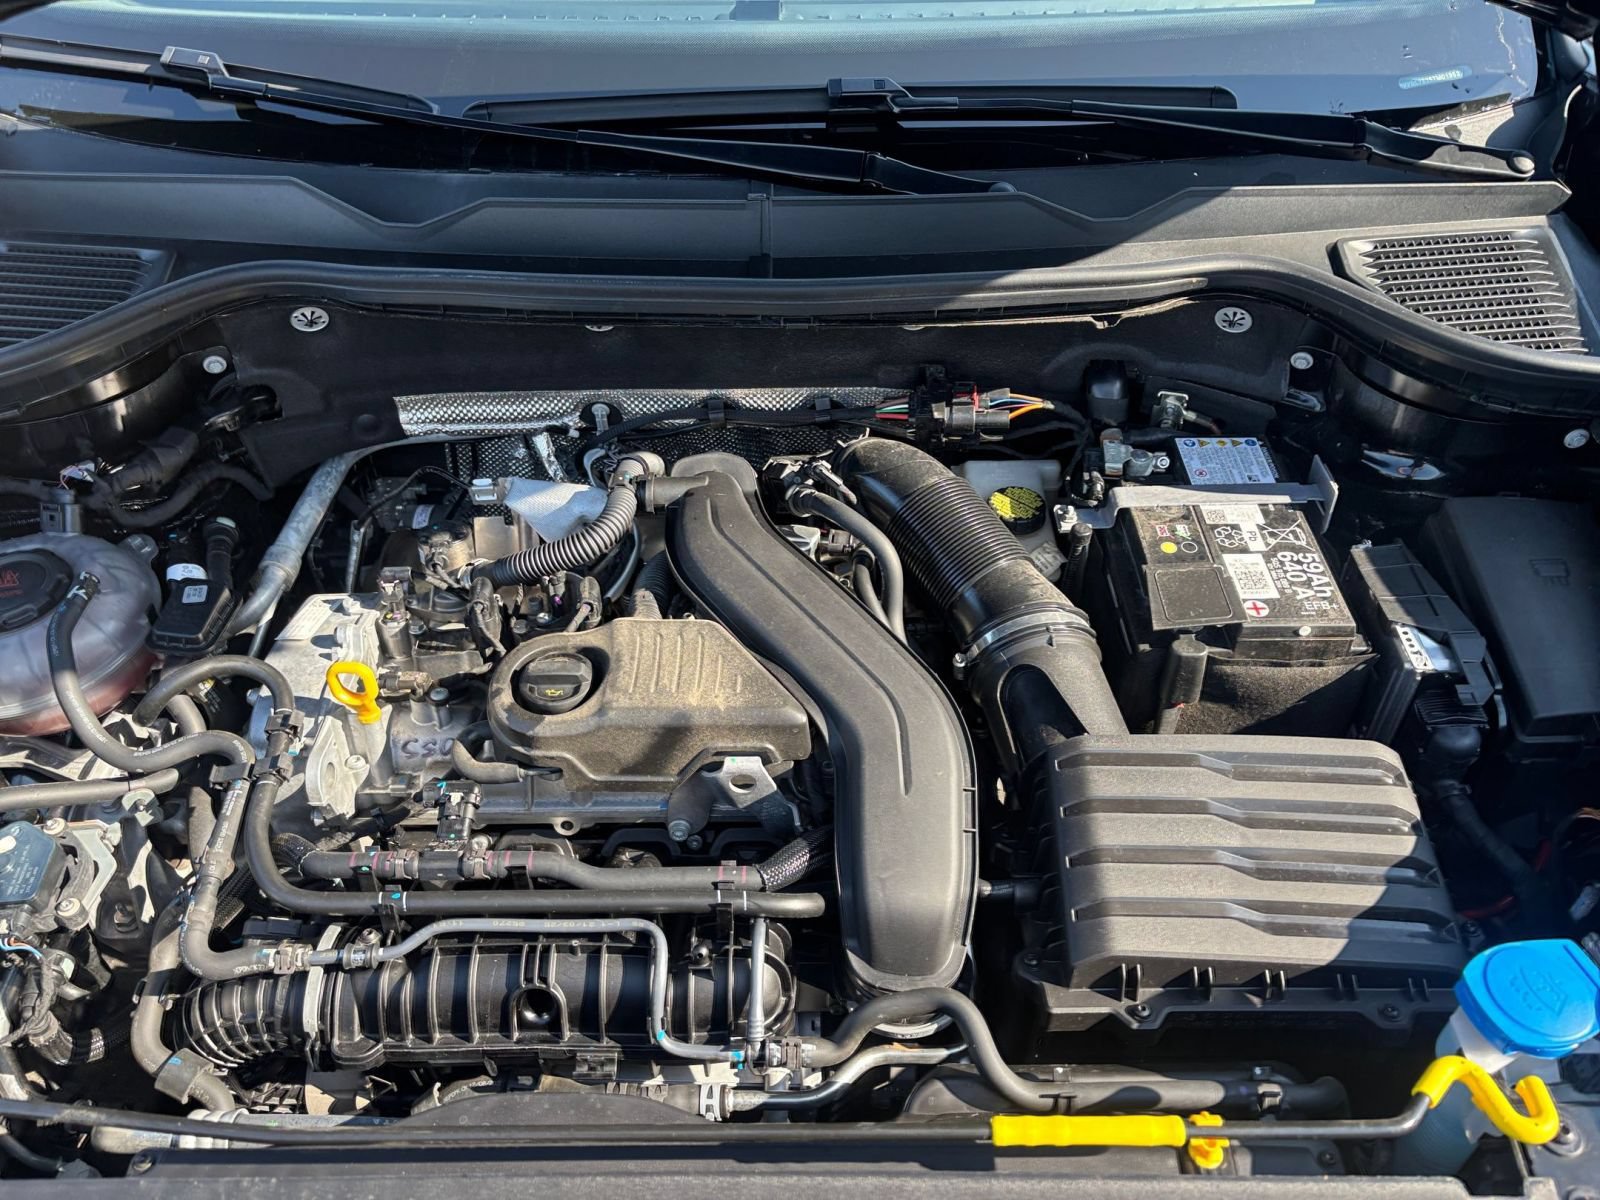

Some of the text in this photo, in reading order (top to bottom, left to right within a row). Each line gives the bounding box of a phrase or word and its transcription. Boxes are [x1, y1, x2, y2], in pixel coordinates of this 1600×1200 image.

[1246, 530, 1257, 542] Pb
[1277, 551, 1308, 582] 640
[1297, 552, 1335, 598] 59Ah
[1292, 586, 1315, 600] A
[1303, 600, 1340, 610] EFB+
